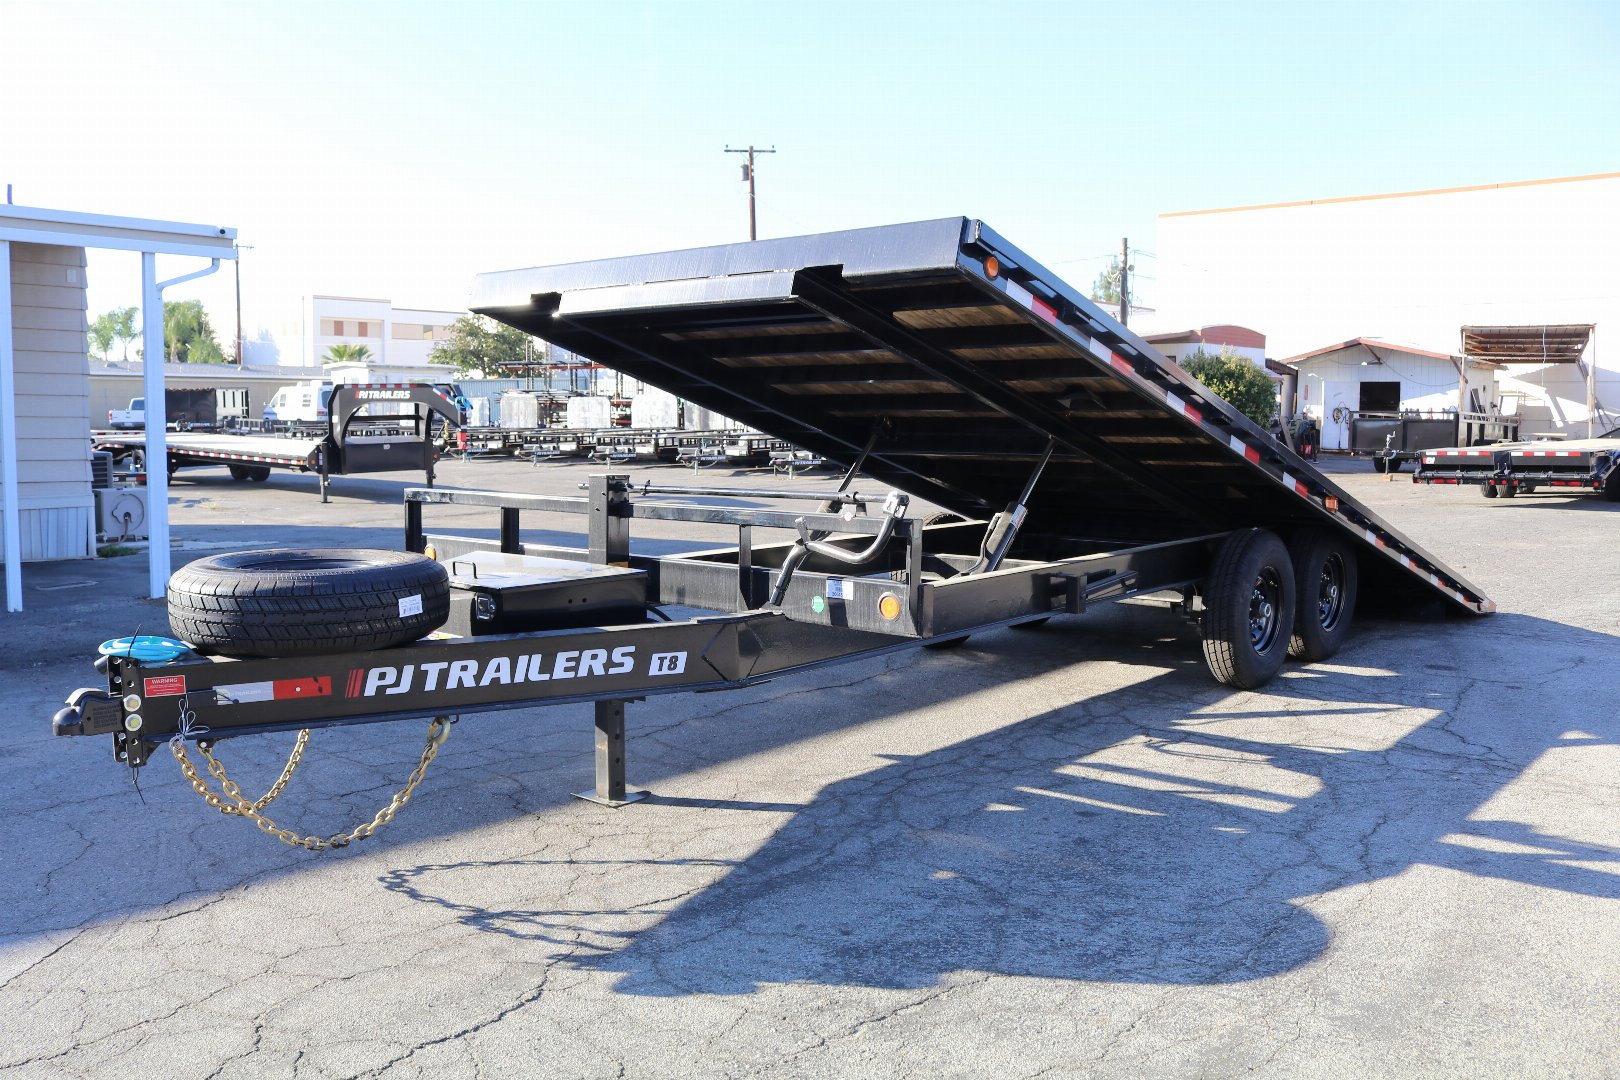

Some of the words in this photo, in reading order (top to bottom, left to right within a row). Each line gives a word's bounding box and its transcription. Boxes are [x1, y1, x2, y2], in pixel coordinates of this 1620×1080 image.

[369, 390, 411, 399] TRAILERS
[363, 664, 415, 697] PJ
[420, 646, 636, 692] TRAILERS
[657, 655, 679, 671] T8
